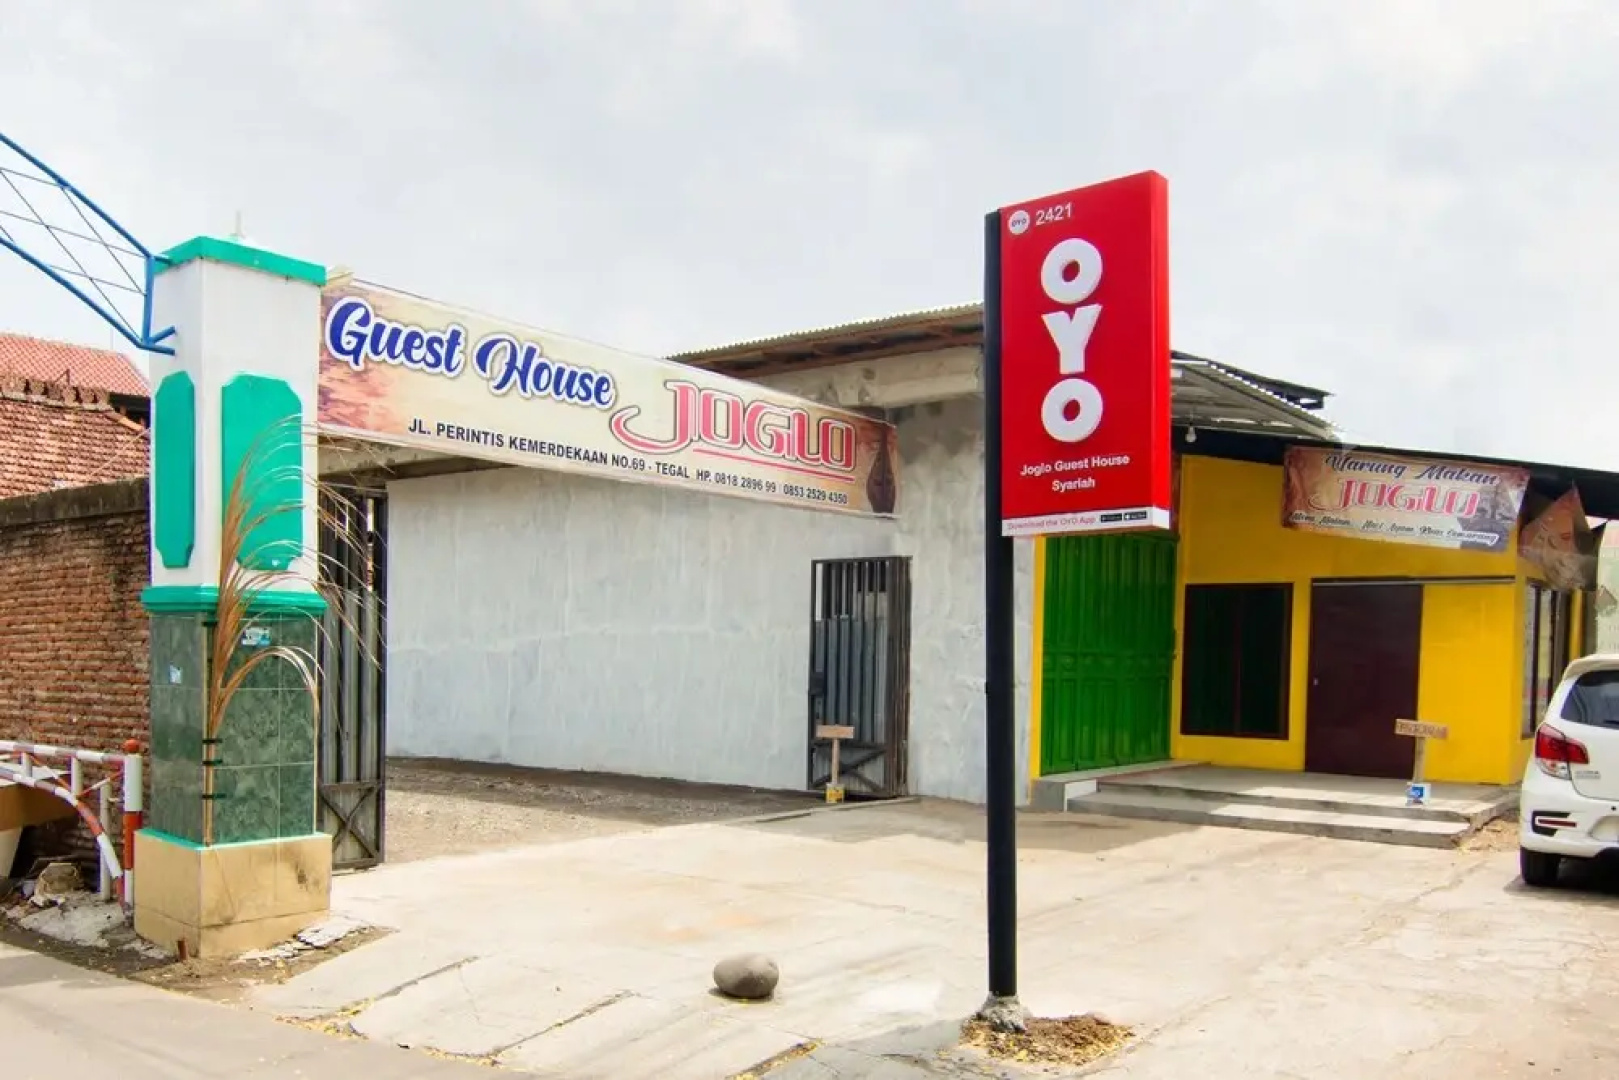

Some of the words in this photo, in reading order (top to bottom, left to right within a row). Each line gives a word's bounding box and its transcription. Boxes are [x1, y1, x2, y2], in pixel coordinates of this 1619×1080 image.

[1036, 202, 1072, 226] 2421
[328, 300, 464, 368] Guest
[475, 337, 613, 407] House
[1041, 237, 1104, 443] OYO
[609, 379, 856, 471] JOGLO
[408, 418, 432, 435] JL.
[436, 422, 505, 448] PERINTIS
[509, 435, 608, 465] KEMERDEKAAN
[611, 454, 646, 472] NO.69
[655, 461, 690, 479] TEGAL
[696, 468, 712, 482] HP.
[714, 472, 738, 487] 0818
[741, 476, 763, 491] 2896
[765, 480, 777, 493] 99
[783, 483, 804, 498] 0853
[806, 487, 826, 501] 2529
[828, 491, 848, 504] 4350
[1020, 462, 1051, 477] Joglo
[1054, 457, 1089, 472] Guest
[1091, 453, 1130, 467] House
[1052, 476, 1096, 493] Syariah
[1325, 453, 1408, 479] Warung
[1414, 464, 1498, 486] Makan
